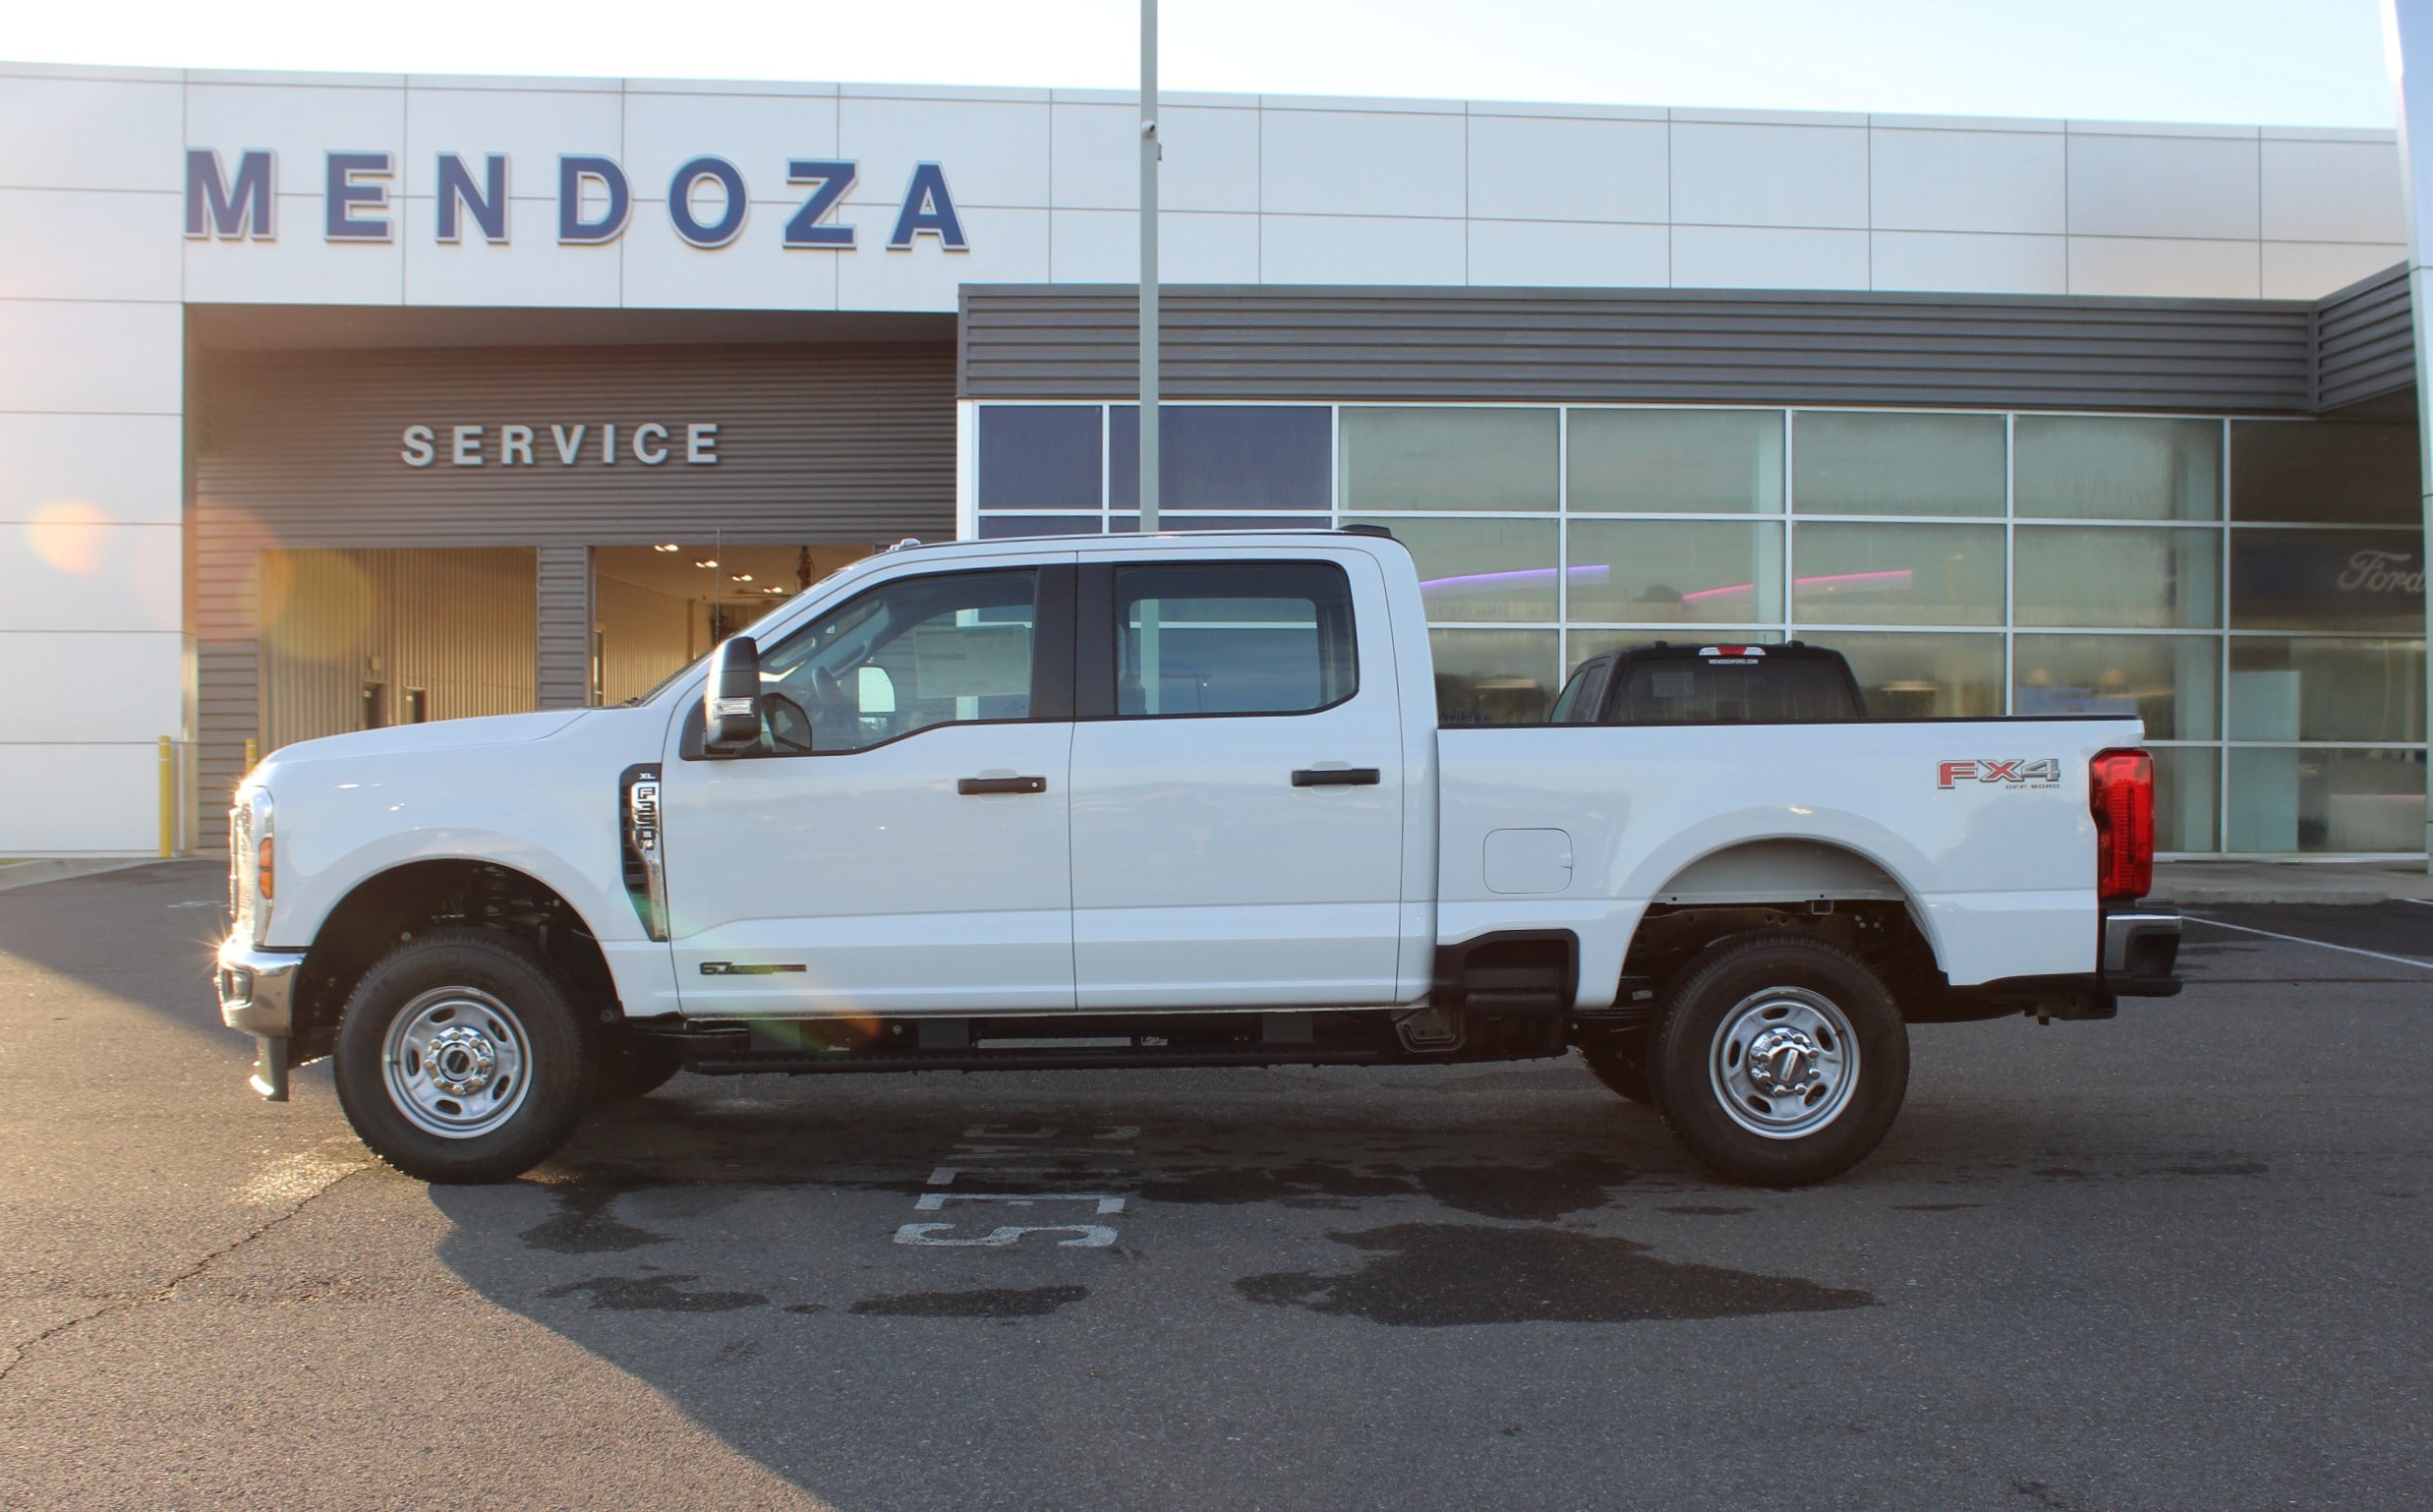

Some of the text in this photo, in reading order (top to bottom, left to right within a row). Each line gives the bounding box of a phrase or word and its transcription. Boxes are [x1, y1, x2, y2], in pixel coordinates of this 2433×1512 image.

[184, 146, 970, 251] MENDOZA
[400, 423, 720, 467] SERVICE
[1937, 758, 2061, 789] FX4
